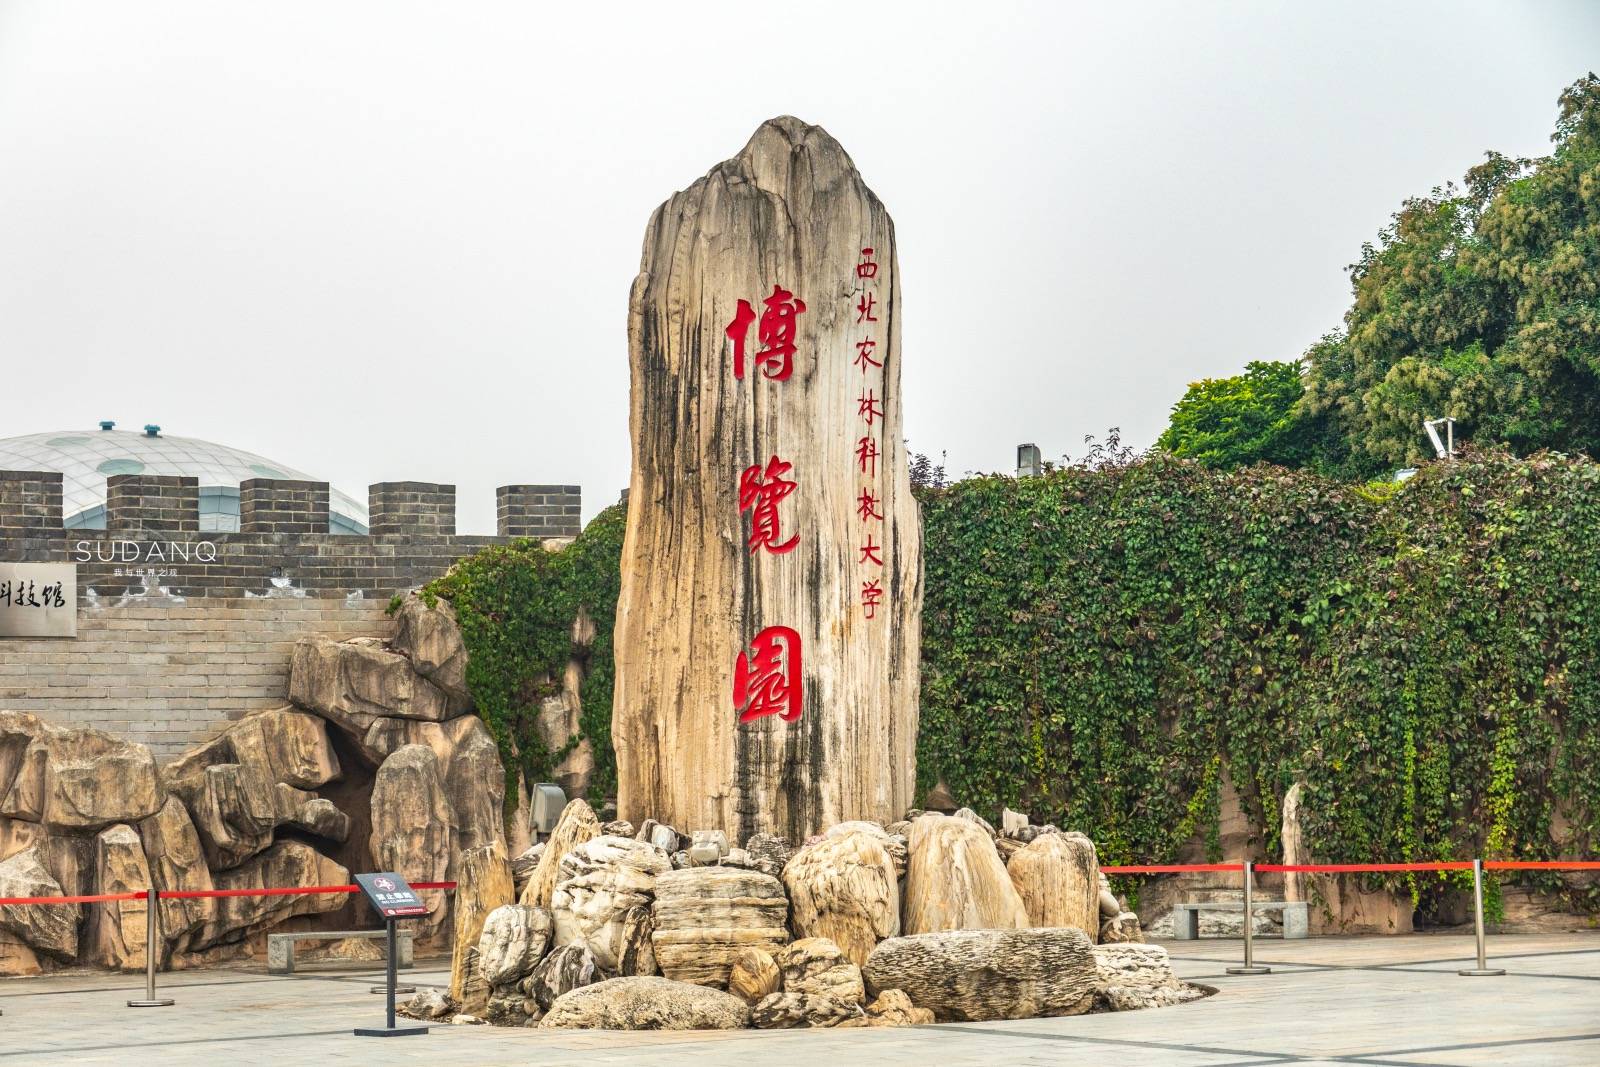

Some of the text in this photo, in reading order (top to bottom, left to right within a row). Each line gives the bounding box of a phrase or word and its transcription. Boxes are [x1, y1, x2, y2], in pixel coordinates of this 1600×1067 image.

[854, 248, 884, 619] 西北农林科技大学
